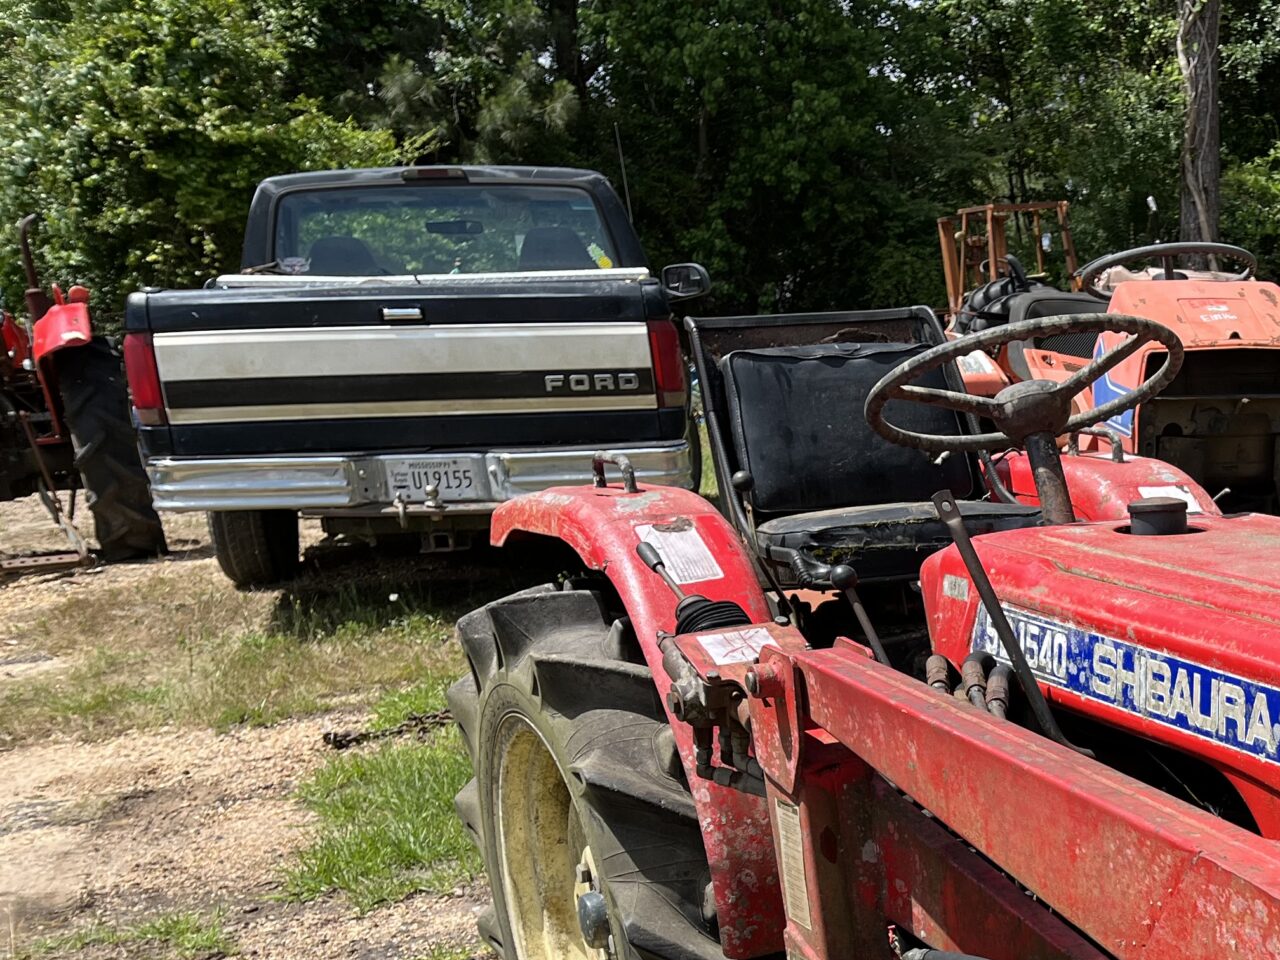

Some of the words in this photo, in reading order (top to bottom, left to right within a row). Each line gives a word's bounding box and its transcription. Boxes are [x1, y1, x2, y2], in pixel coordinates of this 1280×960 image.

[544, 373, 640, 392] FORD
[412, 470, 473, 490] U19155
[1091, 641, 1278, 754] SHIBAURA
